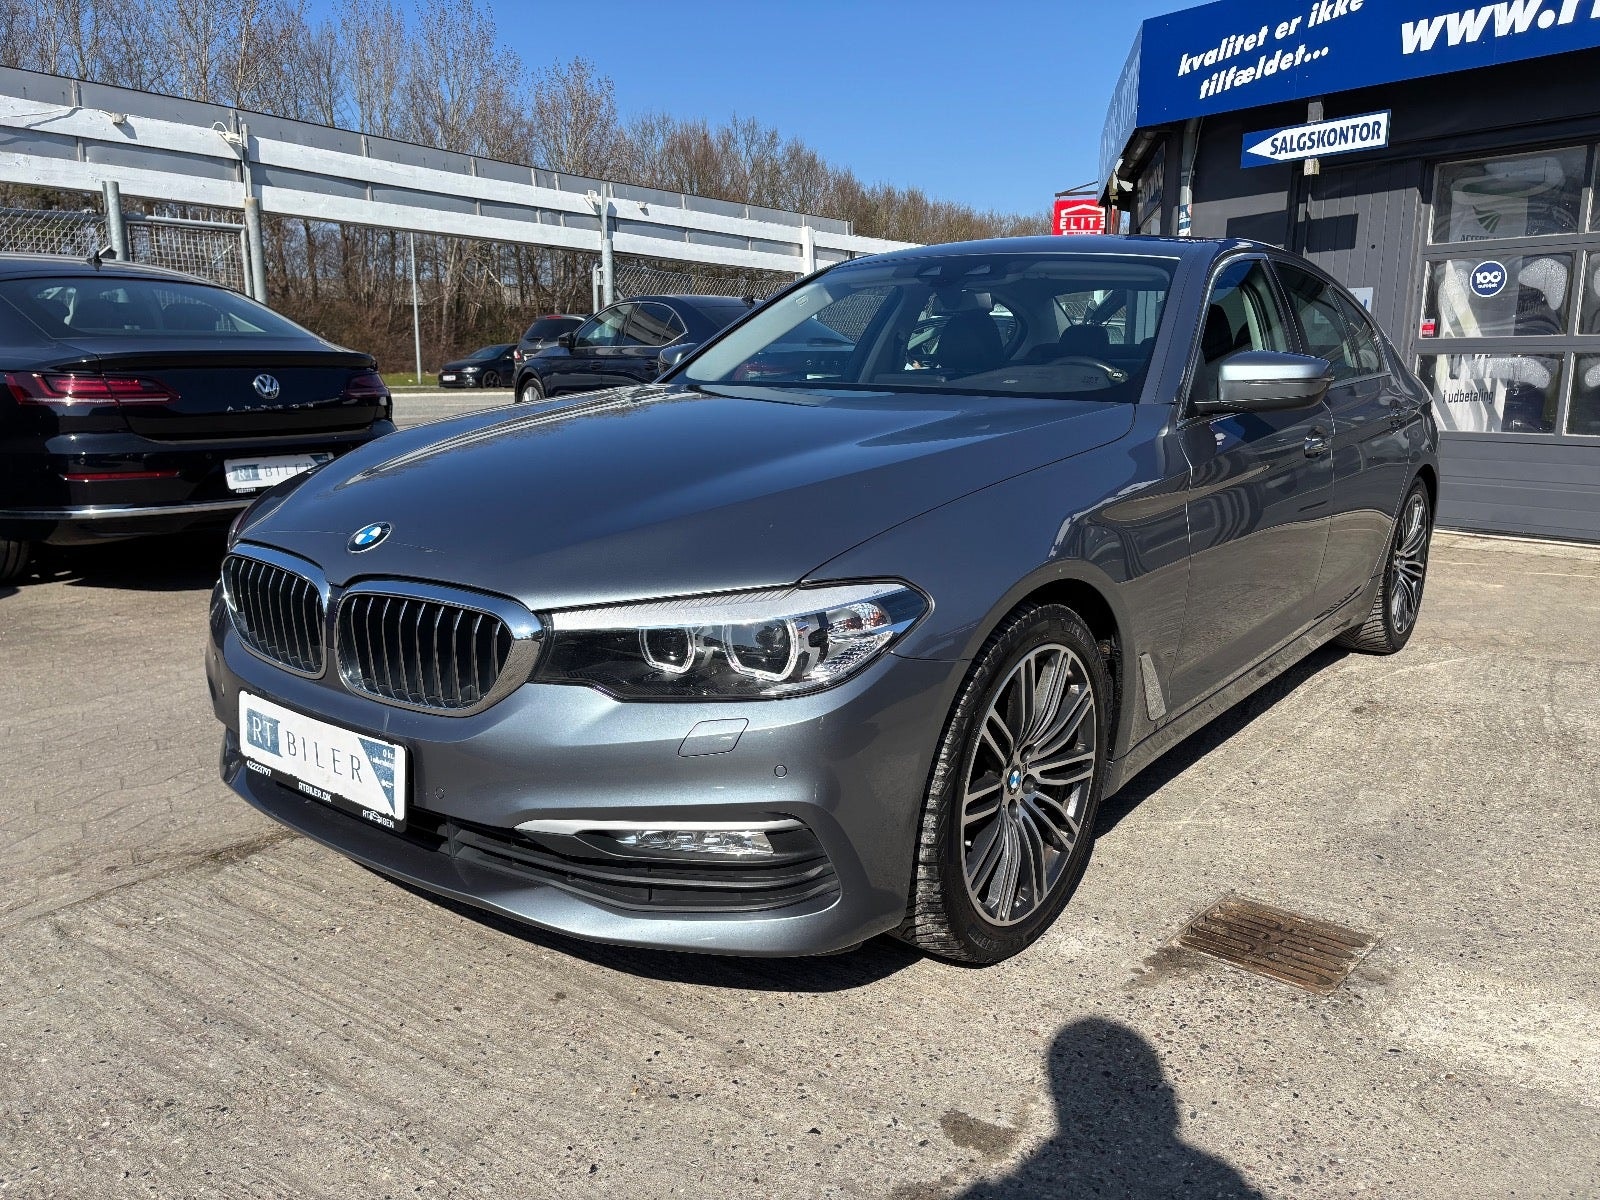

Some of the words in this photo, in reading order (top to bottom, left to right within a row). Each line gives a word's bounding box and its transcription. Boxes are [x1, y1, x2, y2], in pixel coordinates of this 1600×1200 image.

[1178, 25, 1268, 77] kvalitet
[1275, 16, 1302, 39] er
[1308, 0, 1363, 28] ikke
[1401, 0, 1600, 54] www.r
[1200, 44, 1329, 99] tilfældet...
[1270, 121, 1381, 155] SALGSKONTOR
[1060, 217, 1105, 229] ELITE
[1449, 389, 1494, 404] udbetaling
[252, 716, 273, 747] RT
[286, 730, 363, 783] BILER
[298, 782, 332, 803] RTBILER.DK
